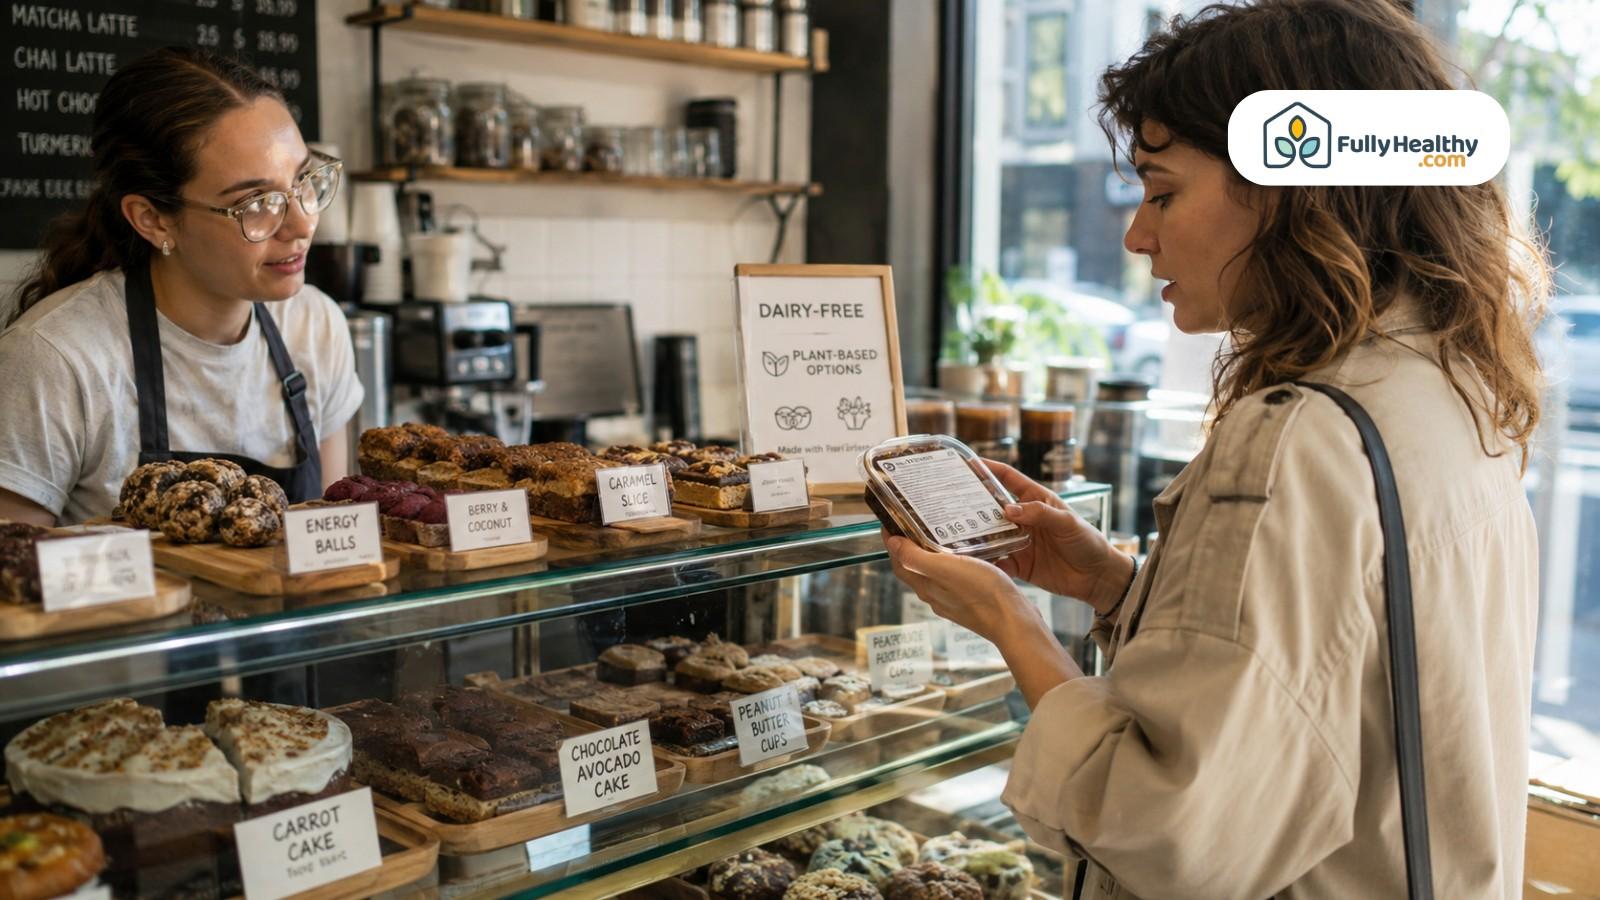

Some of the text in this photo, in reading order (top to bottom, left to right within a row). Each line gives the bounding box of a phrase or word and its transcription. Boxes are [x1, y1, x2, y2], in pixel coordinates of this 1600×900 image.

[12, 3, 139, 38] MATCHA LATTE
[13, 46, 118, 75] CHAI LATTE
[16, 88, 51, 112] HOT
[759, 303, 865, 319] DAIRY-FREE
[792, 349, 878, 361] PLANT-BASED
[806, 364, 863, 376] OPTIONS
[777, 446, 802, 454] Made
[805, 445, 823, 453] with
[609, 473, 656, 490] CARAMEL
[468, 501, 508, 516] BERRY &
[621, 492, 649, 507] SLICE
[305, 513, 359, 534] ENERGY
[467, 517, 512, 533] COCONUT
[315, 536, 356, 554] BALLS
[738, 695, 783, 720] PEANUT
[751, 712, 790, 737] BUTTER
[571, 729, 640, 762] CHOCOLATE
[761, 732, 788, 753] CUPS
[577, 750, 641, 783] AVOCADO
[594, 773, 630, 798] CAKE
[272, 804, 341, 842] CARROT
[287, 831, 336, 861] CAKE
